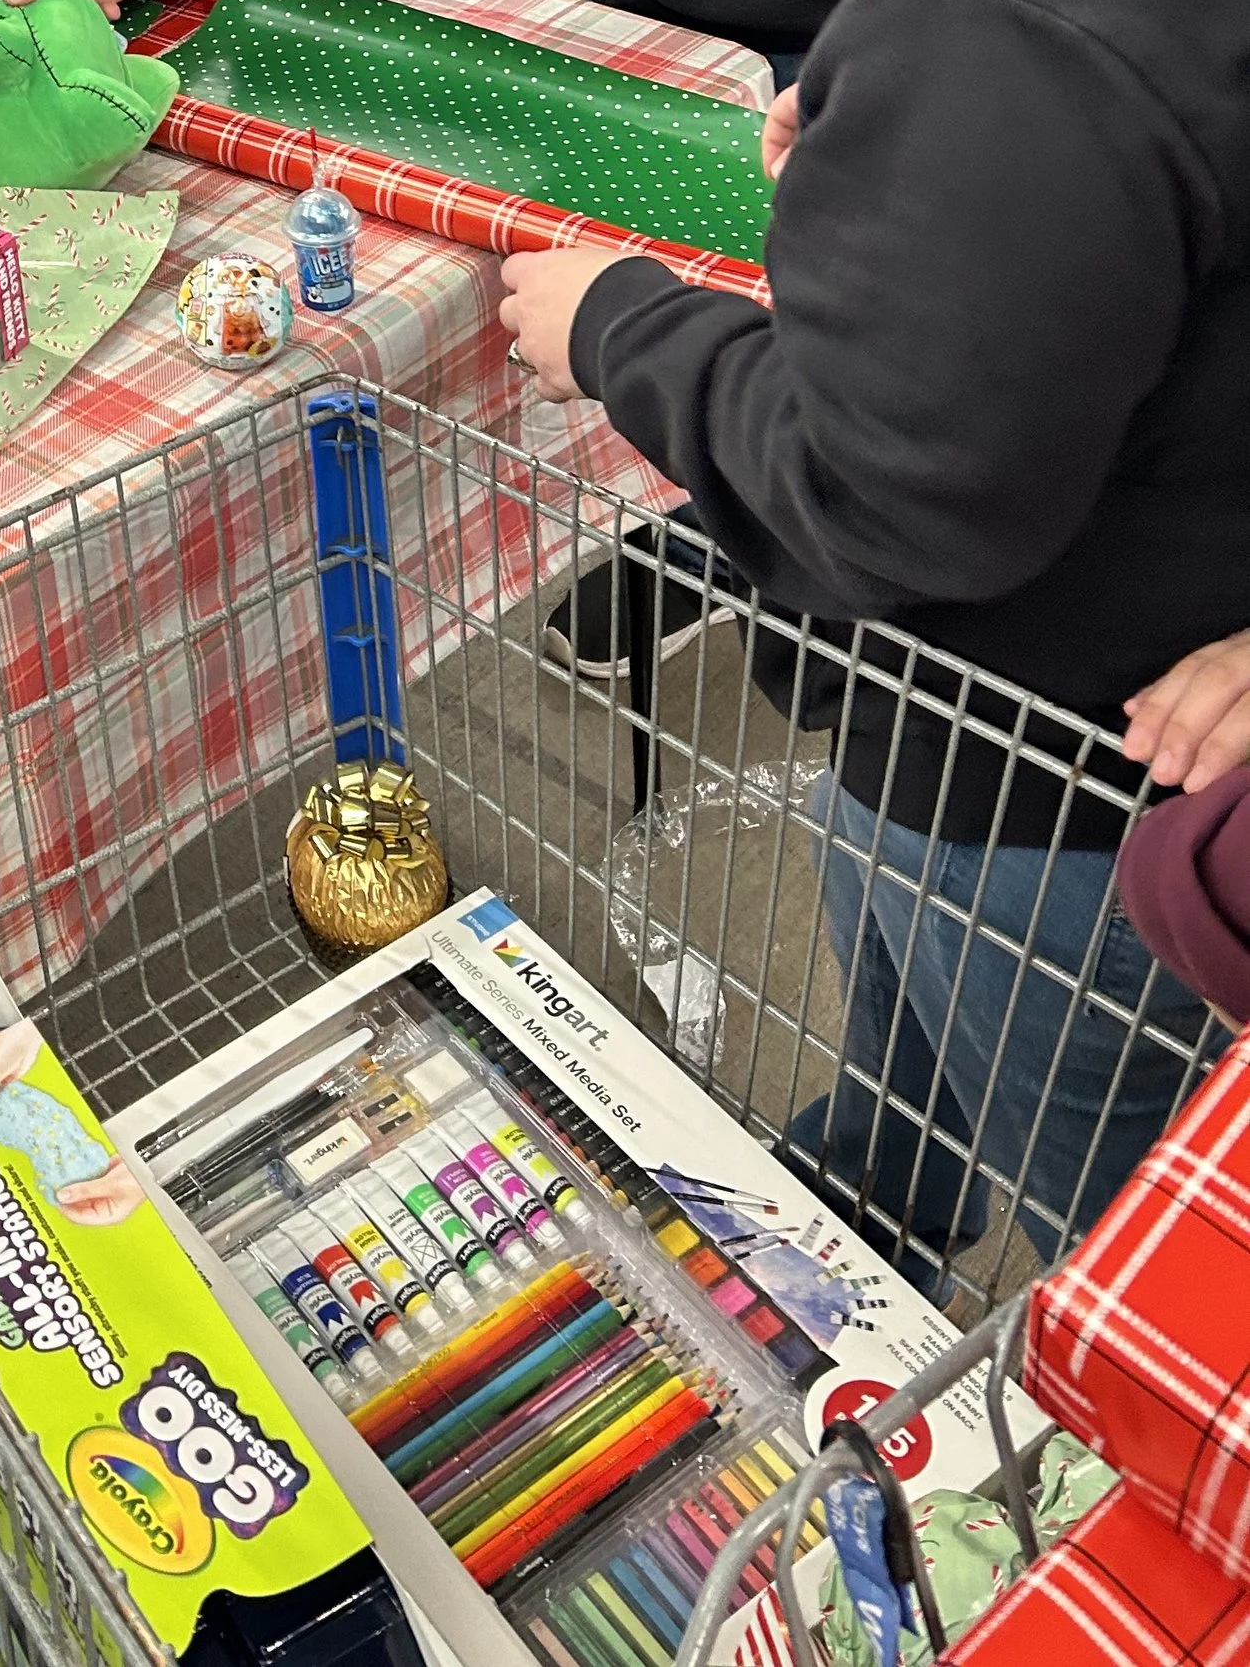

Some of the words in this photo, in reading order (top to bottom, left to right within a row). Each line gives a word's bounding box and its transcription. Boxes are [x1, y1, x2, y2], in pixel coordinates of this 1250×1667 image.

[4, 248, 19, 295] HELLO
[313, 250, 348, 277] ICEE
[1, 292, 16, 351] FRIENDS
[10, 296, 26, 339] KITTY
[431, 930, 484, 981] Ultimate
[482, 979, 525, 1022] Series
[522, 1018, 571, 1062] Mixed
[565, 1060, 614, 1106] Media
[612, 1104, 643, 1134] Set
[16, 1185, 33, 1204] and
[25, 1199, 57, 1241] customize
[351, 1225, 376, 1245] YELLOW
[358, 1232, 380, 1250] LEMON
[63, 1261, 80, 1279] you
[72, 1275, 92, 1299] stuff
[30, 1263, 122, 1387] SENSORY
[85, 1295, 114, 1333] stretchy
[168, 1365, 204, 1401] DIY
[886, 1344, 905, 1365] FULL
[942, 1398, 955, 1410] ON
[954, 1409, 977, 1432] BACK
[960, 1396, 985, 1421] PAINT
[138, 1386, 275, 1524] GOO
[198, 1391, 296, 1487] LESS-MESS
[90, 1462, 174, 1555] Crayola
